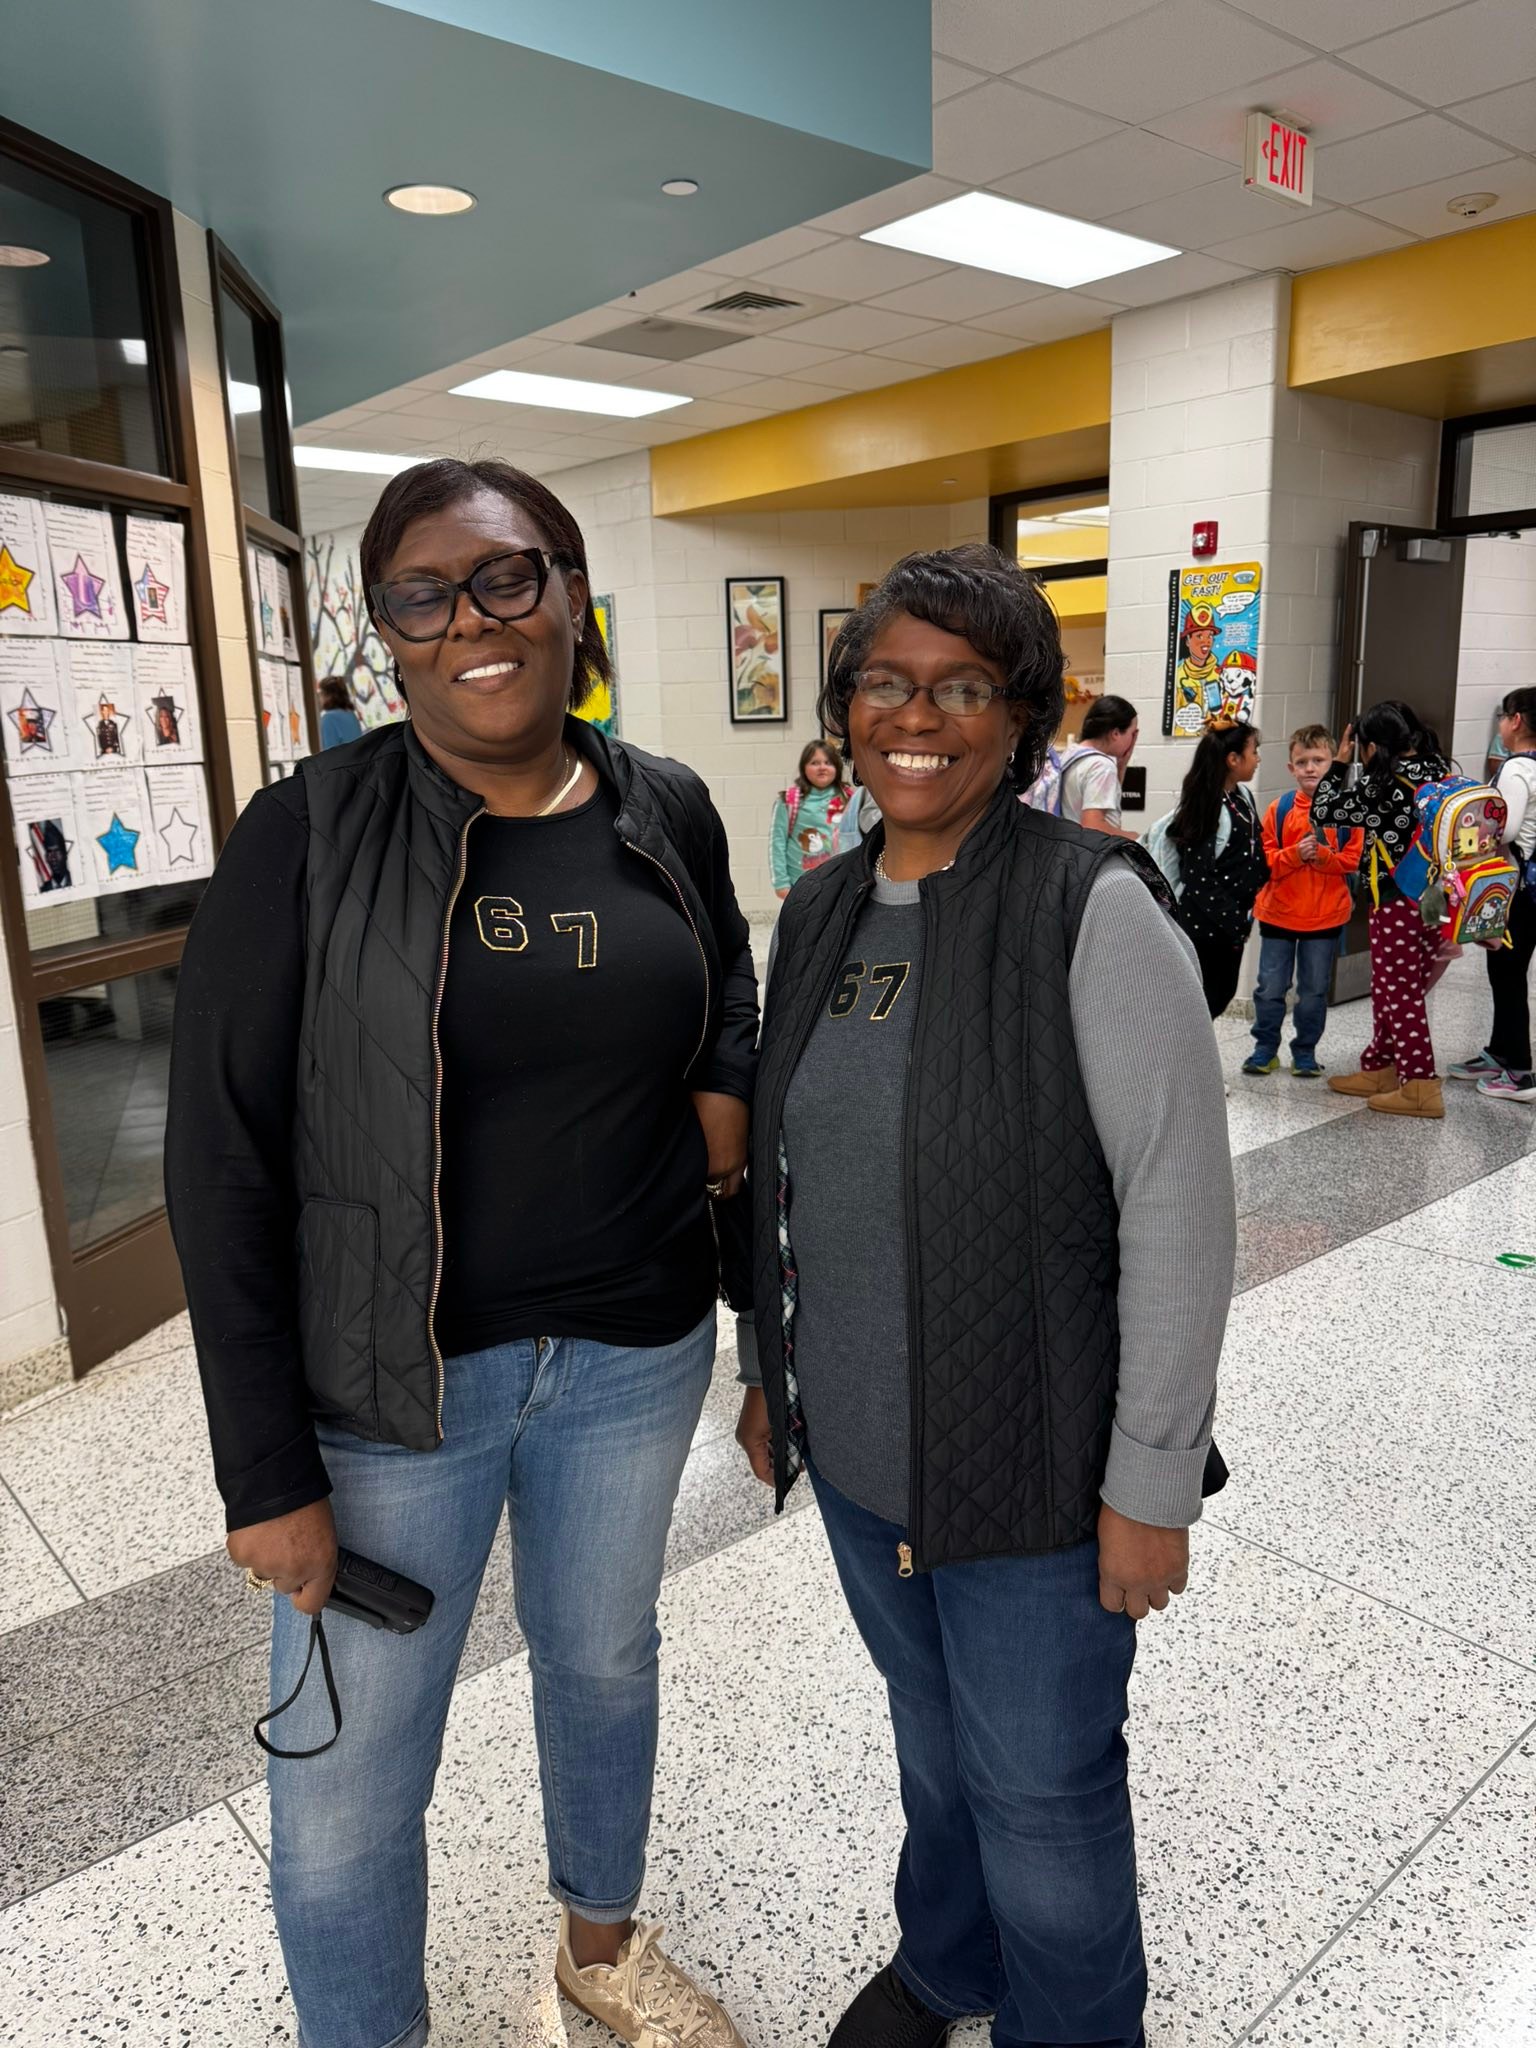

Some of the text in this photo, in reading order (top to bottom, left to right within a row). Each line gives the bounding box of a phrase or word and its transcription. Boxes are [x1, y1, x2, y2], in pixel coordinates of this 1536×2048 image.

[1268, 122, 1307, 194] EXIT
[1183, 571, 1229, 586] GET OUT
[1191, 585, 1221, 597] FAST!
[1231, 652, 1239, 663] 1
